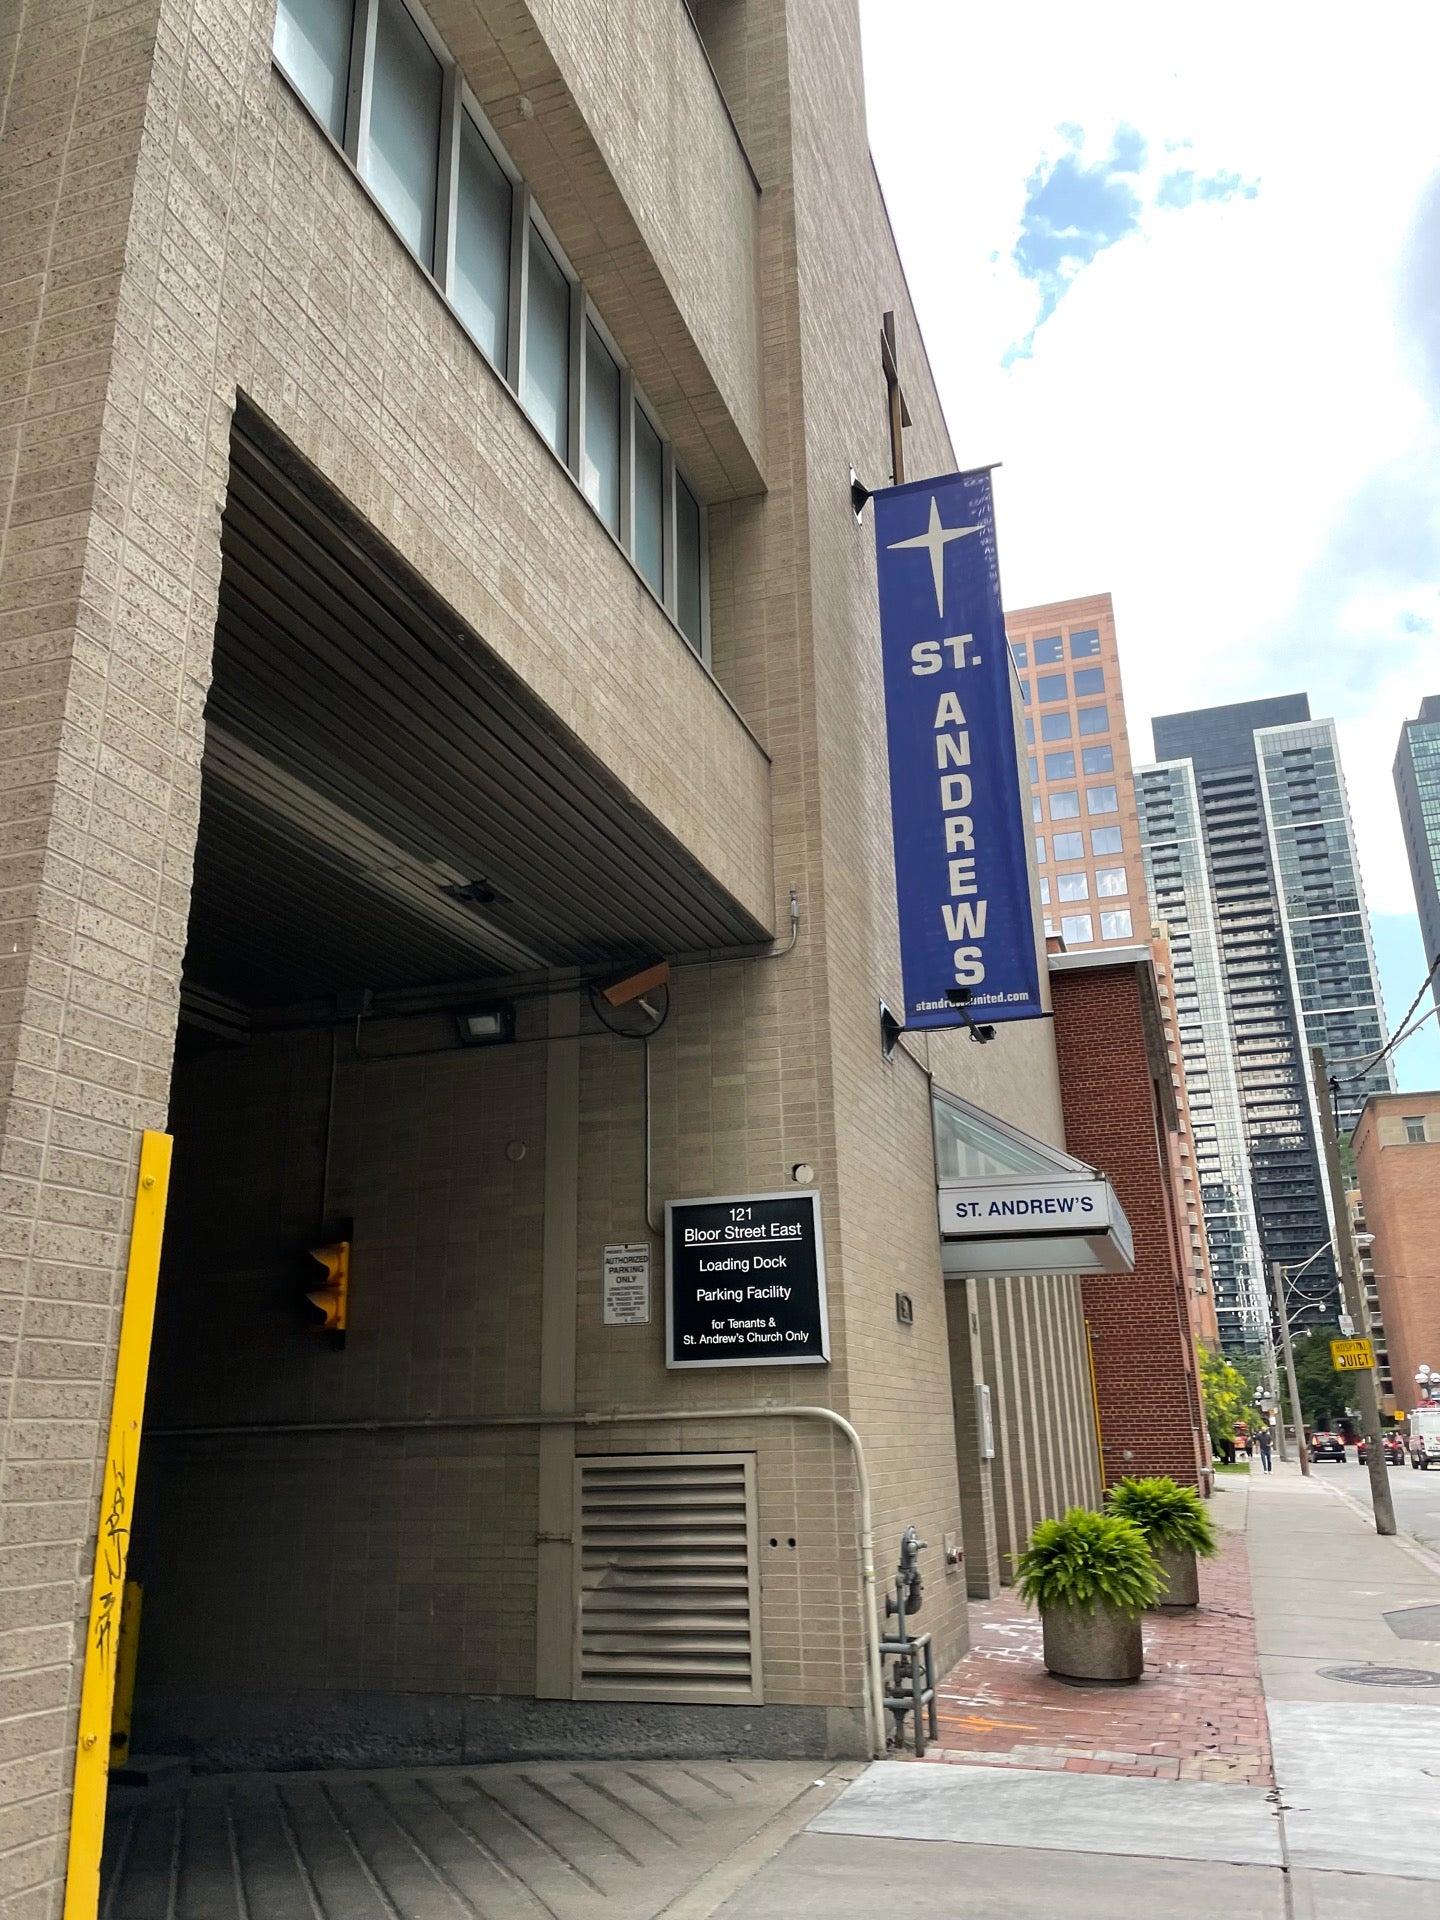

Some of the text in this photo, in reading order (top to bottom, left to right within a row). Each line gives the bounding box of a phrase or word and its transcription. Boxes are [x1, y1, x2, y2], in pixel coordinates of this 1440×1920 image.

[911, 634, 982, 676] ST.
[934, 691, 988, 986] ANDREWS
[729, 1207, 752, 1221] 121
[956, 1196, 1094, 1218] ST. ANDREW'S
[684, 1222, 802, 1242] Bloor Street East
[605, 1255, 649, 1265] AUTHORIZED
[699, 1255, 787, 1273] Loading Dock
[608, 1265, 645, 1274] PARKING
[615, 1275, 637, 1284] ONLY
[697, 1285, 792, 1303] Parking Facility
[711, 1317, 777, 1330] for Tenants &
[683, 1330, 809, 1346] St. Andrew's Church Only
[1338, 1353, 1369, 1367] QUIET
